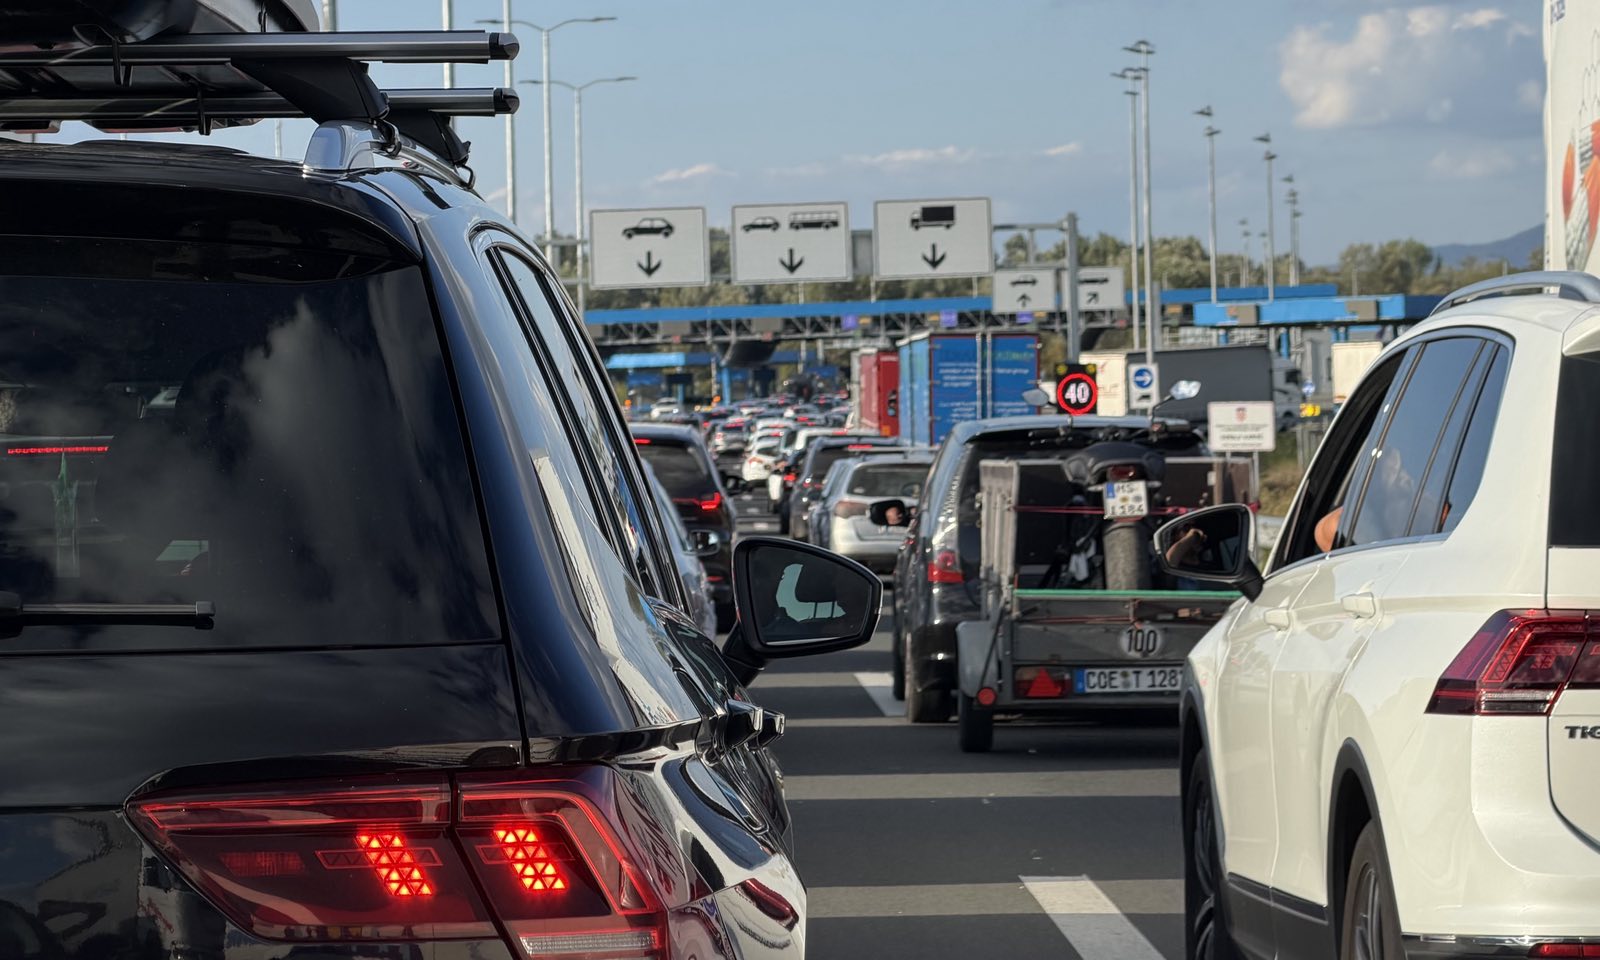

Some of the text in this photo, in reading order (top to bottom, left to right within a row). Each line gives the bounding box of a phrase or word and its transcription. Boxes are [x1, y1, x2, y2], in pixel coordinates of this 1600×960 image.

[1064, 382, 1090, 404] 40
[1126, 628, 1157, 654] 100
[1086, 671, 1119, 689] COE
[1132, 670, 1142, 688] T
